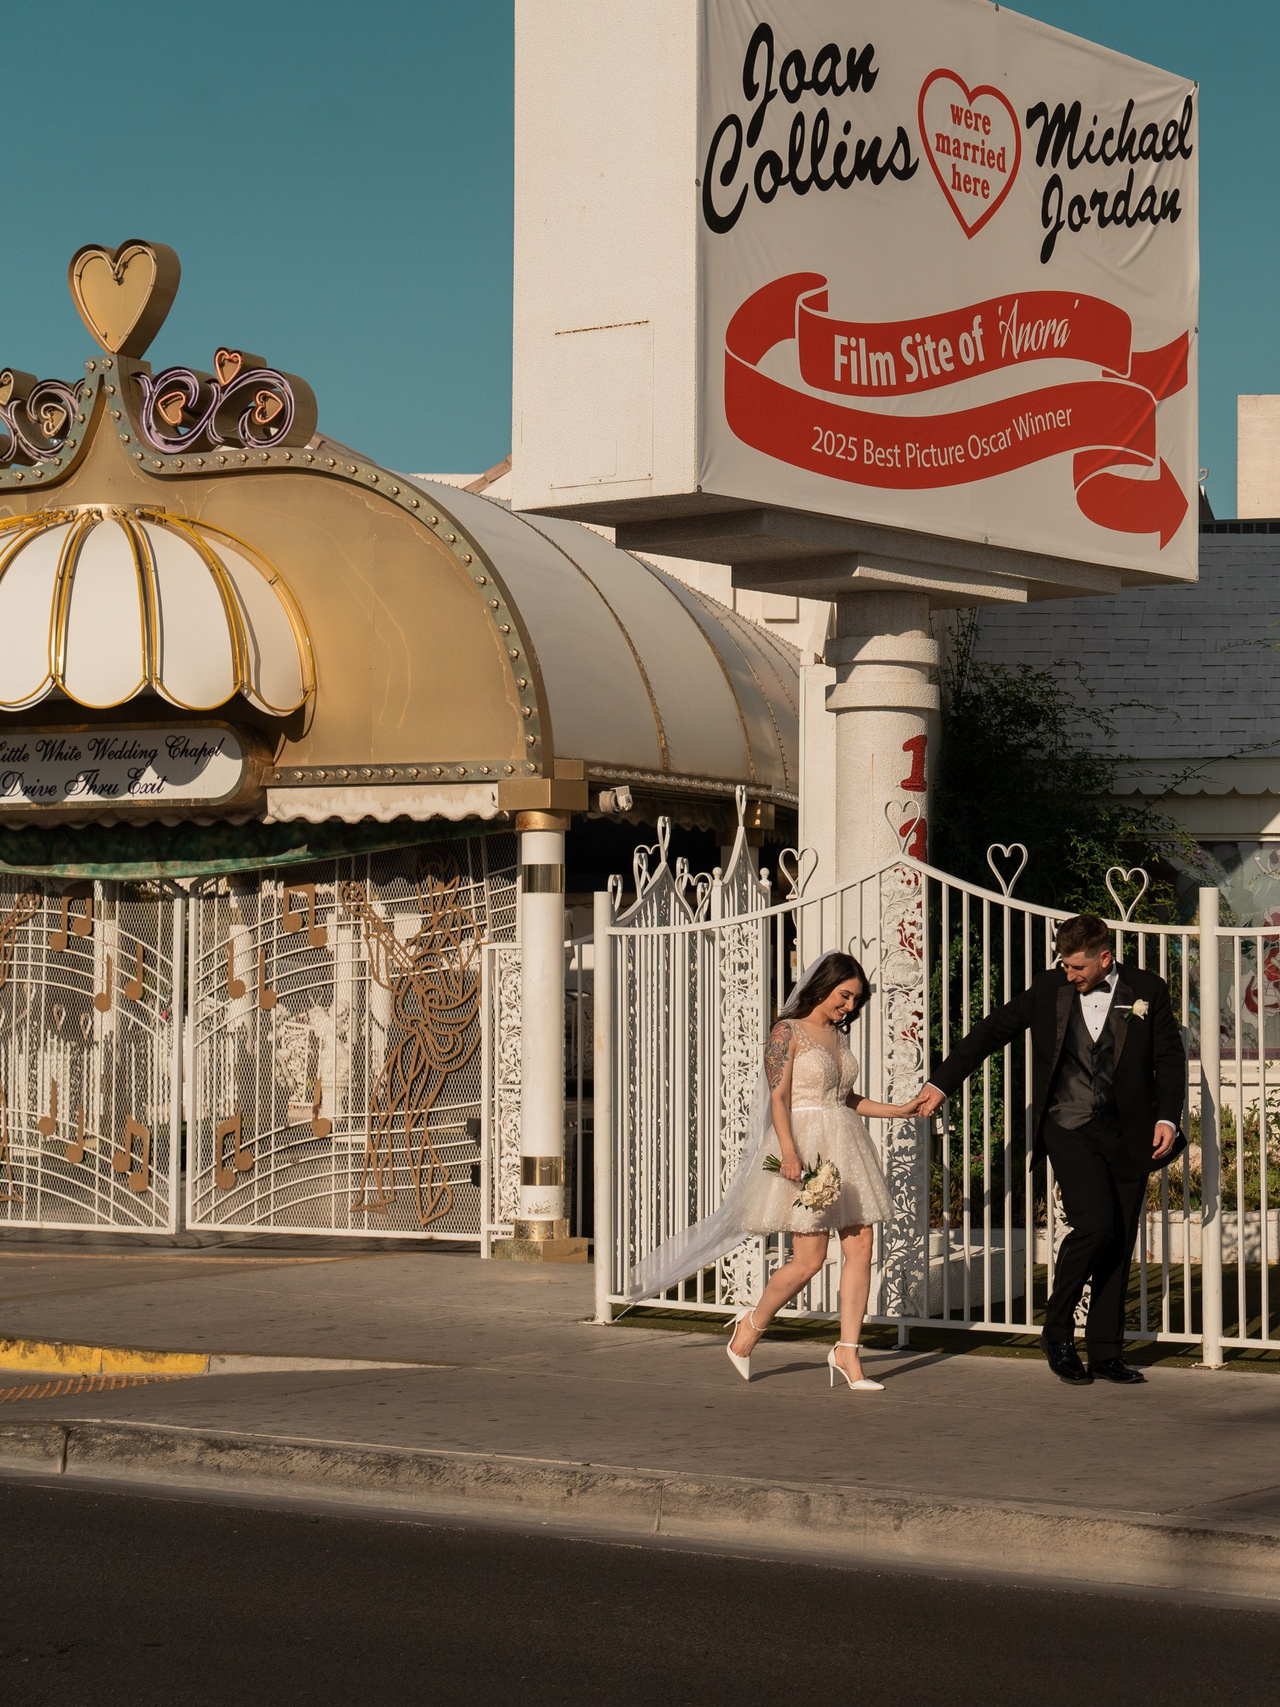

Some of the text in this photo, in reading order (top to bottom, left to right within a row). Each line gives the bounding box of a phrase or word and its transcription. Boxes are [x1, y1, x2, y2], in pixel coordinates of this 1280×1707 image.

[742, 22, 880, 149] Joan
[950, 104, 992, 136] were
[1025, 94, 1193, 171] Michael
[702, 106, 920, 235] Collins
[935, 132, 1007, 174] married
[951, 163, 991, 200] here
[1039, 168, 1183, 265] Jordan
[833, 334, 897, 387] Film
[900, 328, 956, 383] Site
[959, 314, 985, 367] of
[811, 407, 1073, 469] 2025 Best Picture Oscar Winner
[0, 766, 168, 797] Drive Thru Exit
[35, 736, 83, 764] White
[87, 735, 159, 769] Wedding
[165, 734, 226, 765] Chapel
